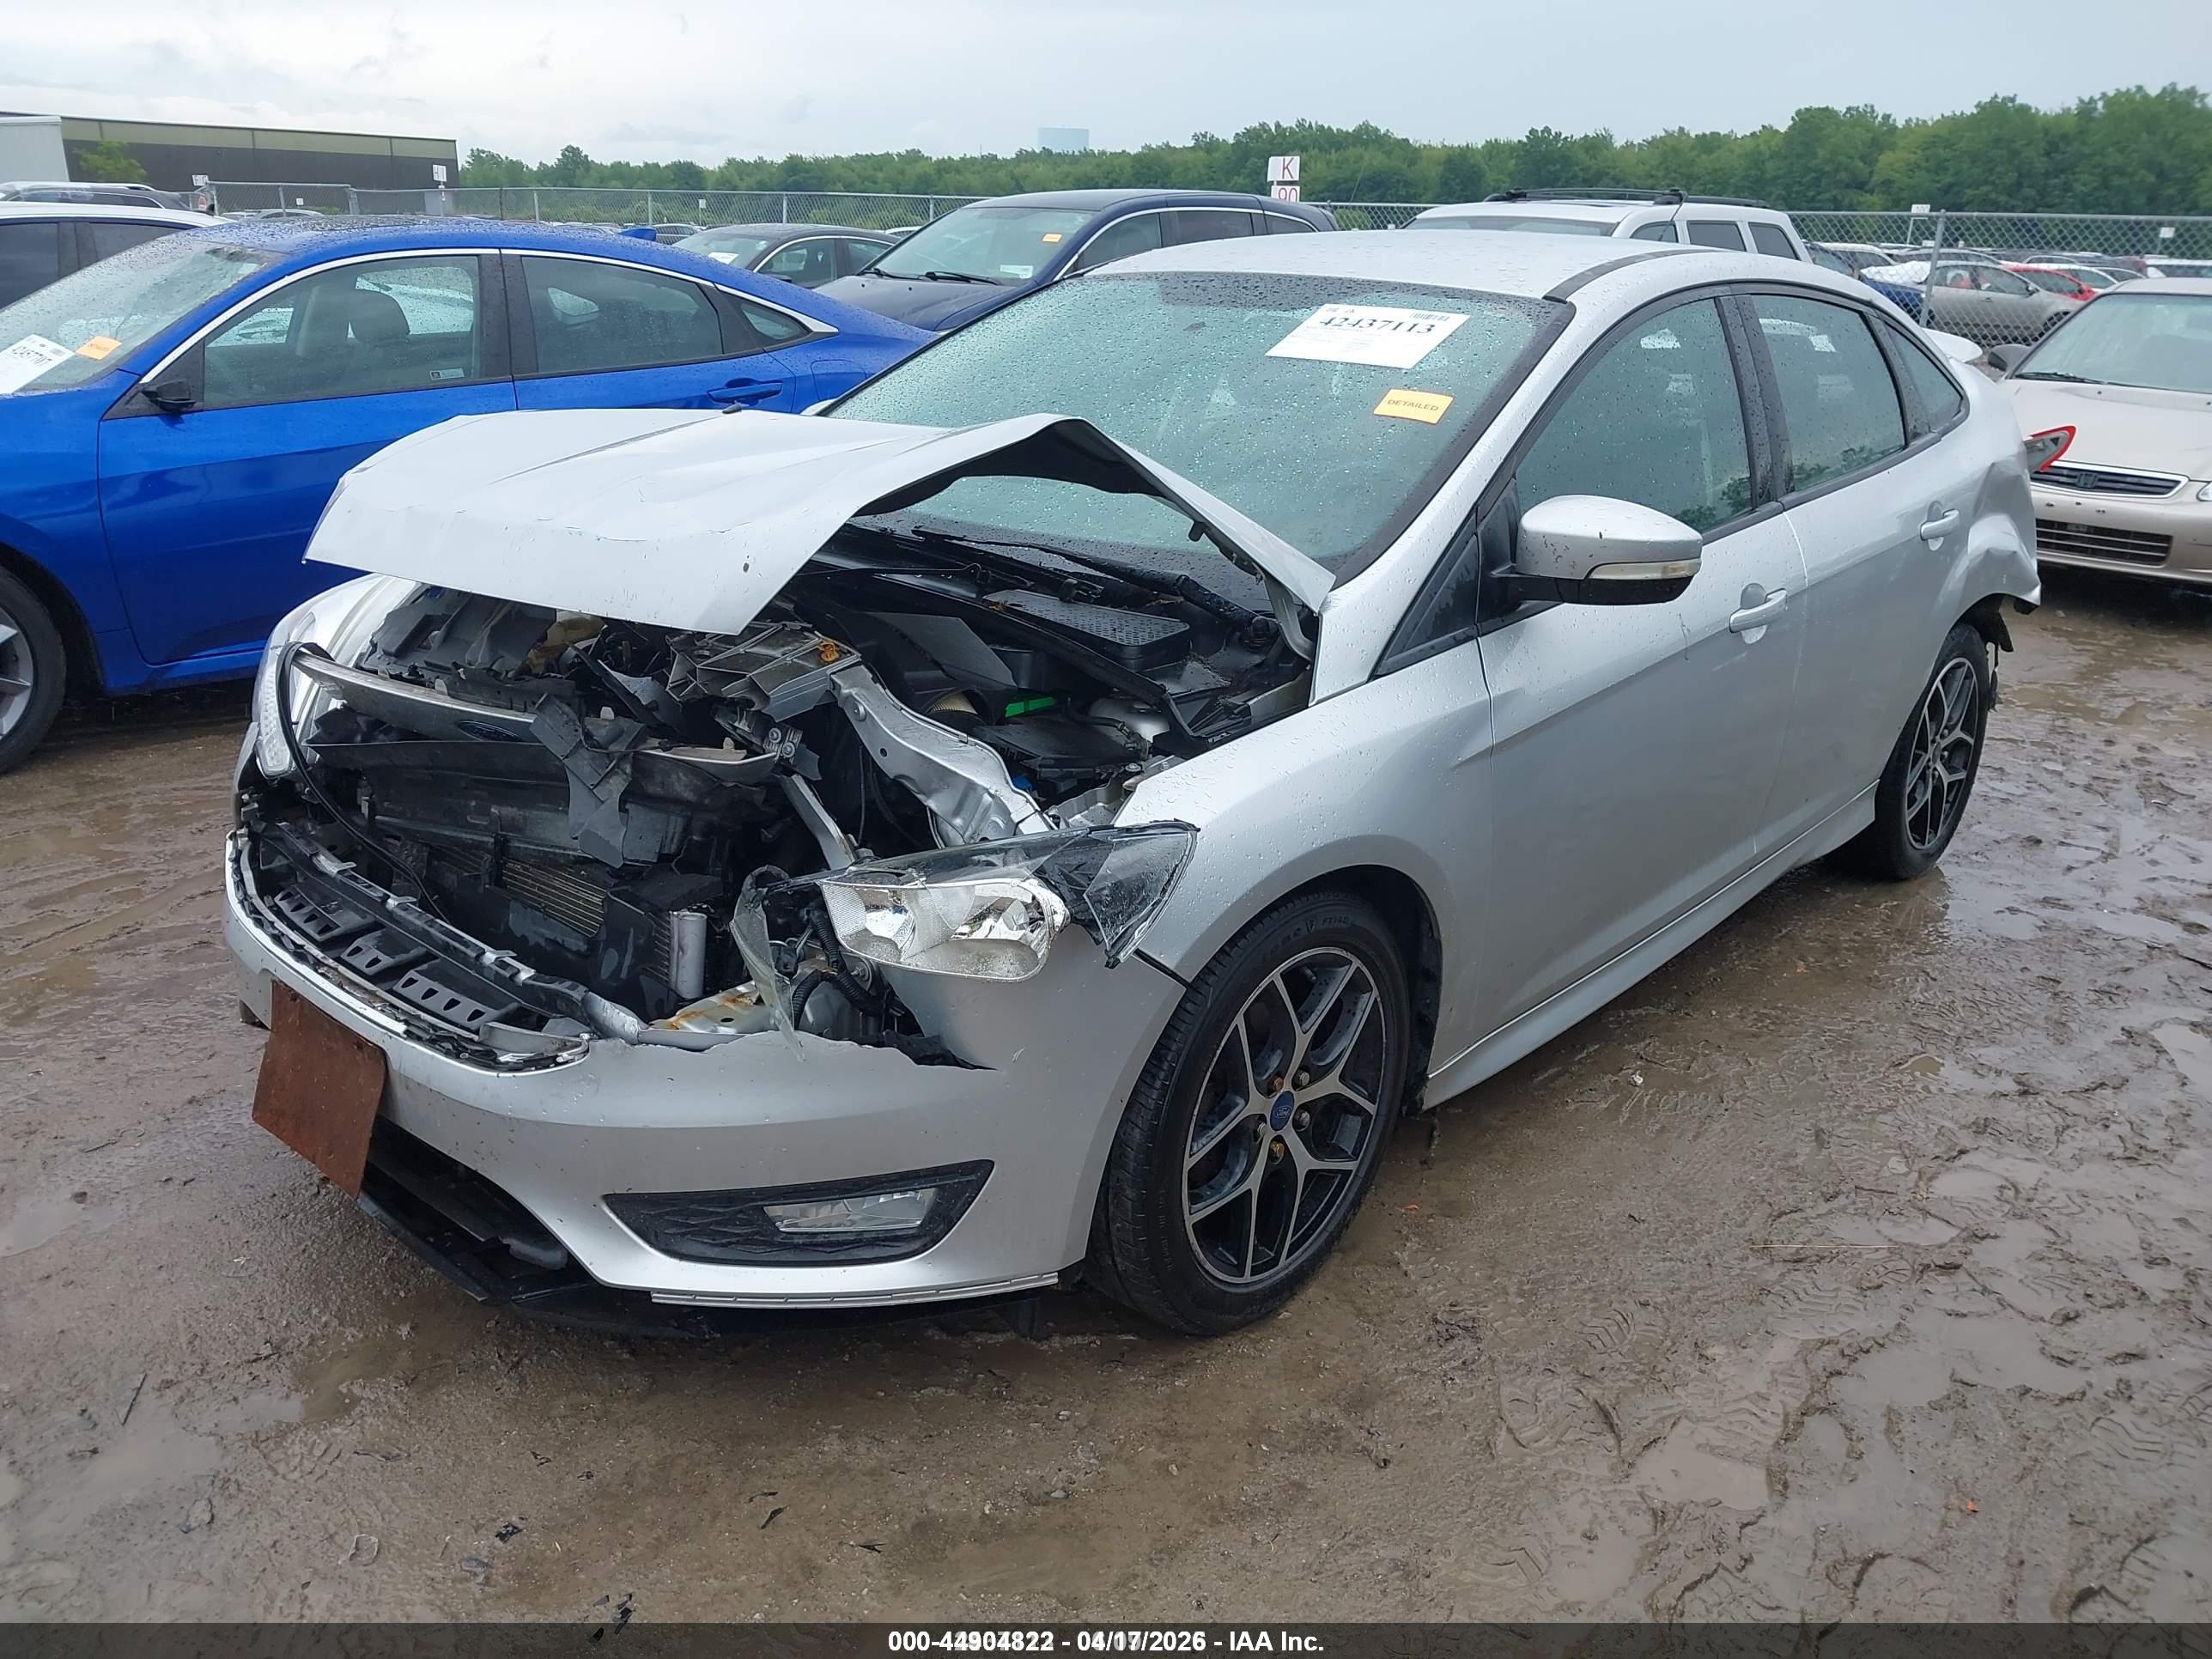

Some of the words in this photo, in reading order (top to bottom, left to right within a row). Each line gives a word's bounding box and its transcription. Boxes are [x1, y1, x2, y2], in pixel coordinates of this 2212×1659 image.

[1282, 157, 1294, 179] K
[1319, 316, 1436, 334] 42437113
[1387, 398, 1439, 412] DETAILED
